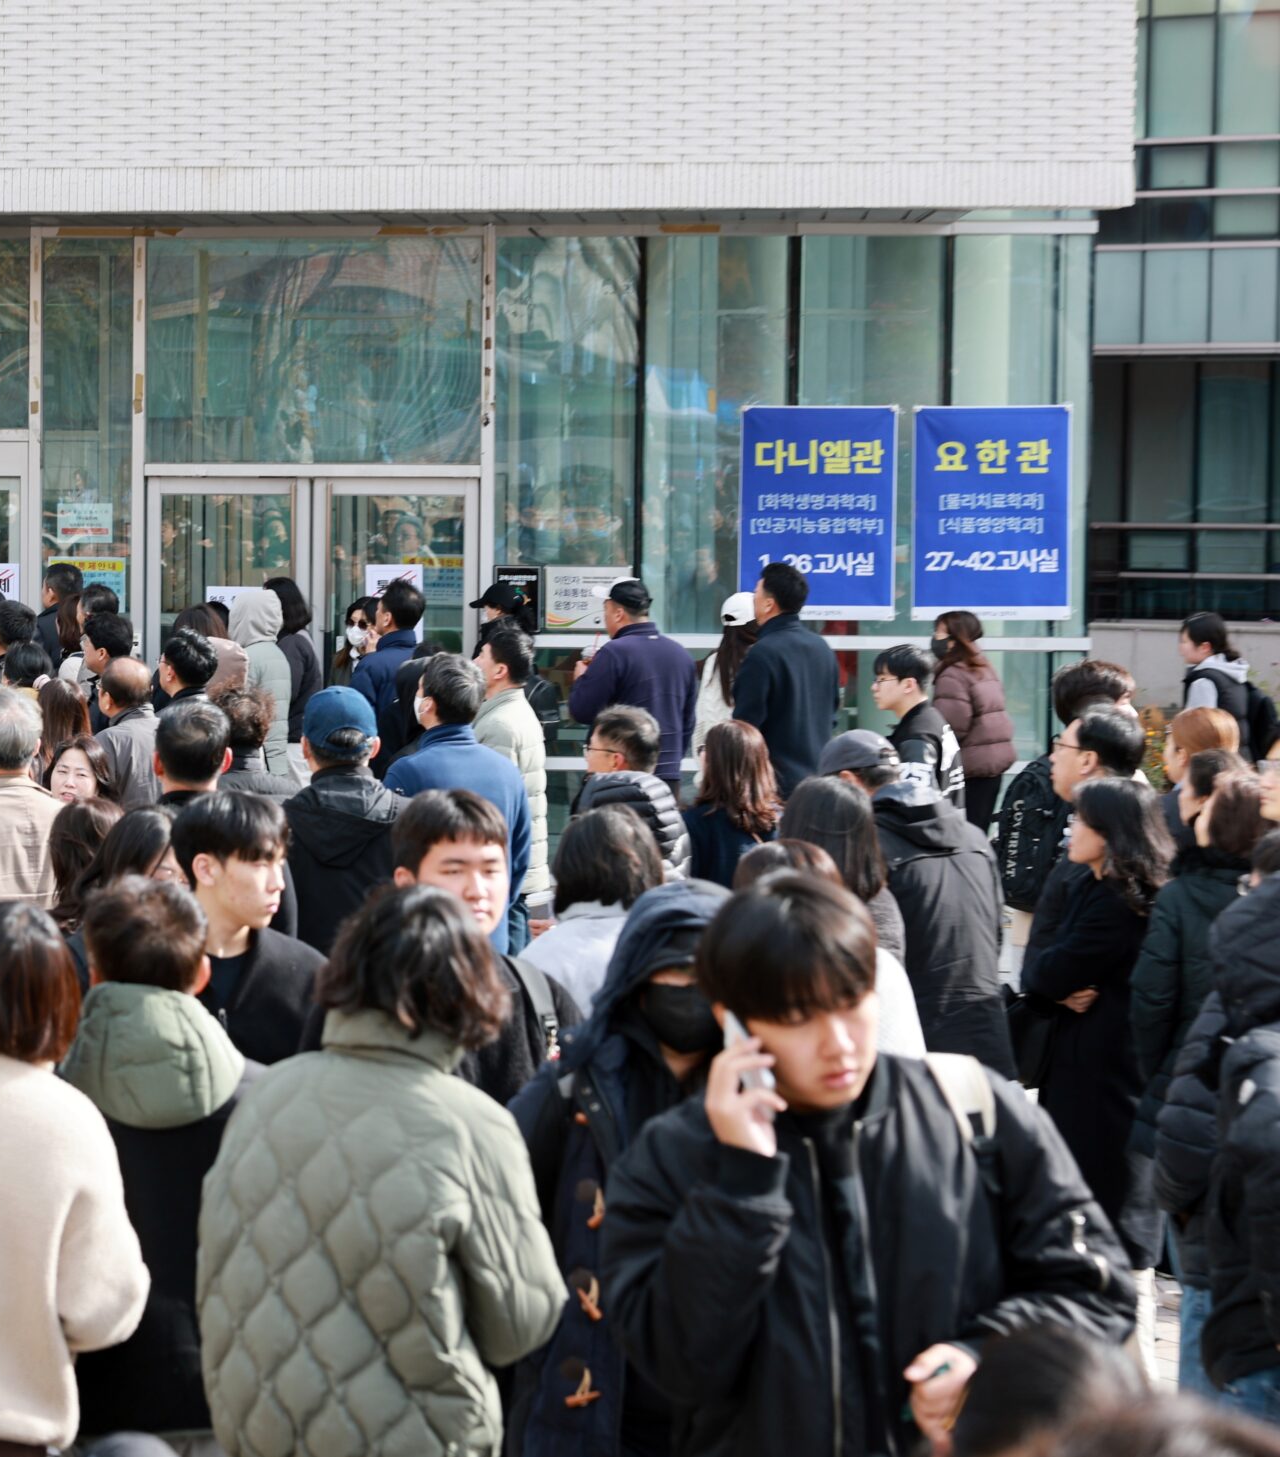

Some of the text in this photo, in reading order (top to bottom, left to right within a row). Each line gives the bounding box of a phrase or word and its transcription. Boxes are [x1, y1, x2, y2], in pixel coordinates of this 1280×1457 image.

[754, 438, 885, 475] 다니엘관
[757, 493, 878, 512] [화학생명과학과]
[938, 493, 1045, 512] [물리치료학과]
[749, 516, 885, 535] [인공지능융합학부]
[938, 516, 1045, 535] [식품영양학과]
[757, 551, 876, 577] 126고사실
[924, 548, 1060, 574] 27~42고사실
[553, 588, 593, 598] 사회통합
